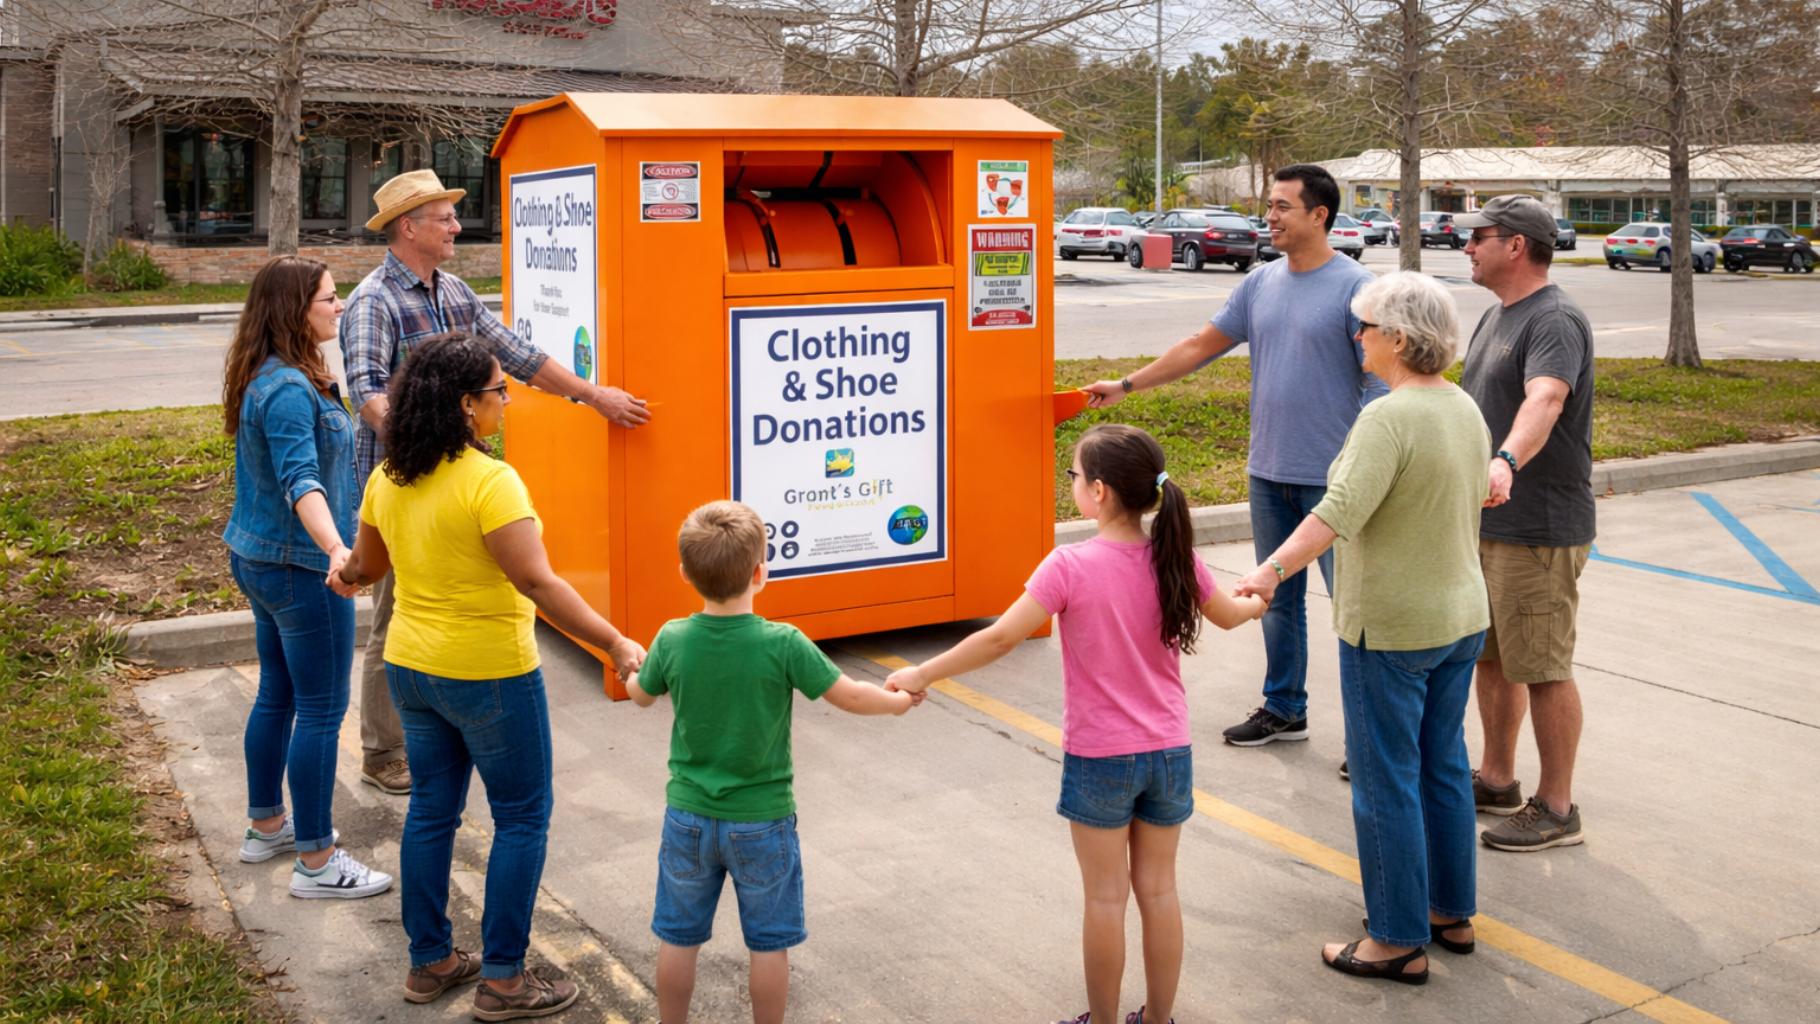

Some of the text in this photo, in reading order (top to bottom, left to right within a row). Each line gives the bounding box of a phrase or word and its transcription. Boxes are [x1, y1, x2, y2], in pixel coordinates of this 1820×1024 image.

[563, 192, 592, 227] Shoe
[767, 325, 911, 364] Clothing
[782, 366, 898, 402] & Shoe
[753, 406, 926, 446] Donations
[859, 478, 893, 498] Gift
